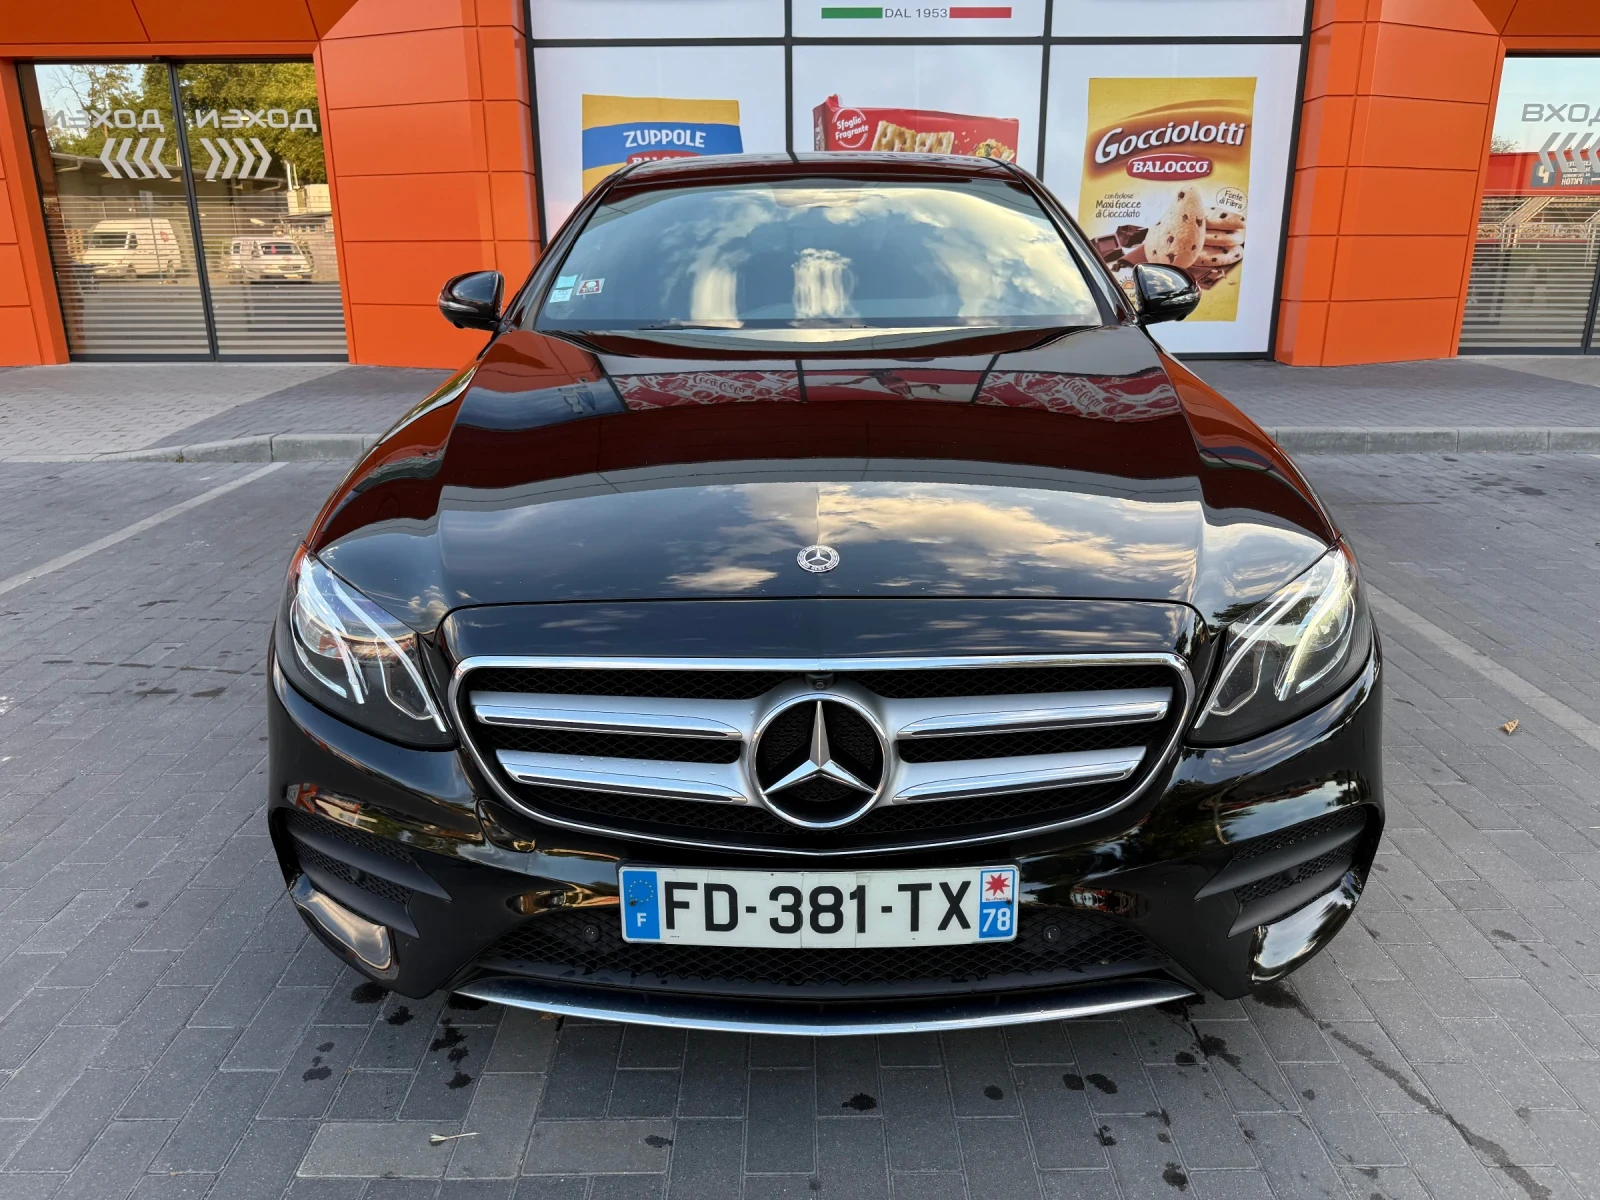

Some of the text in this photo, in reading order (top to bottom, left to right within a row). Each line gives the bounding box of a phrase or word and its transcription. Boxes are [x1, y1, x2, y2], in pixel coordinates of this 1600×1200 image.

[885, 8, 947, 18] DAL 1953
[44, 109, 165, 132] ИЗХОД
[195, 109, 317, 133] ИЗХОД
[837, 117, 862, 131] Sfoglia
[623, 129, 706, 148] ZUPPOLE
[835, 125, 869, 140] Fragrante
[1095, 121, 1245, 164] Gocciolotti
[1133, 161, 1209, 173] BALOCCO
[1225, 190, 1244, 201] Fonte
[1095, 200, 1142, 209] Maxi Gocce
[1226, 199, 1243, 209] Fibra
[1096, 209, 1140, 218] di Cioccolato
[663, 880, 972, 935] FD-381-TX
[637, 913, 647, 927] F
[982, 907, 1011, 933] 78
